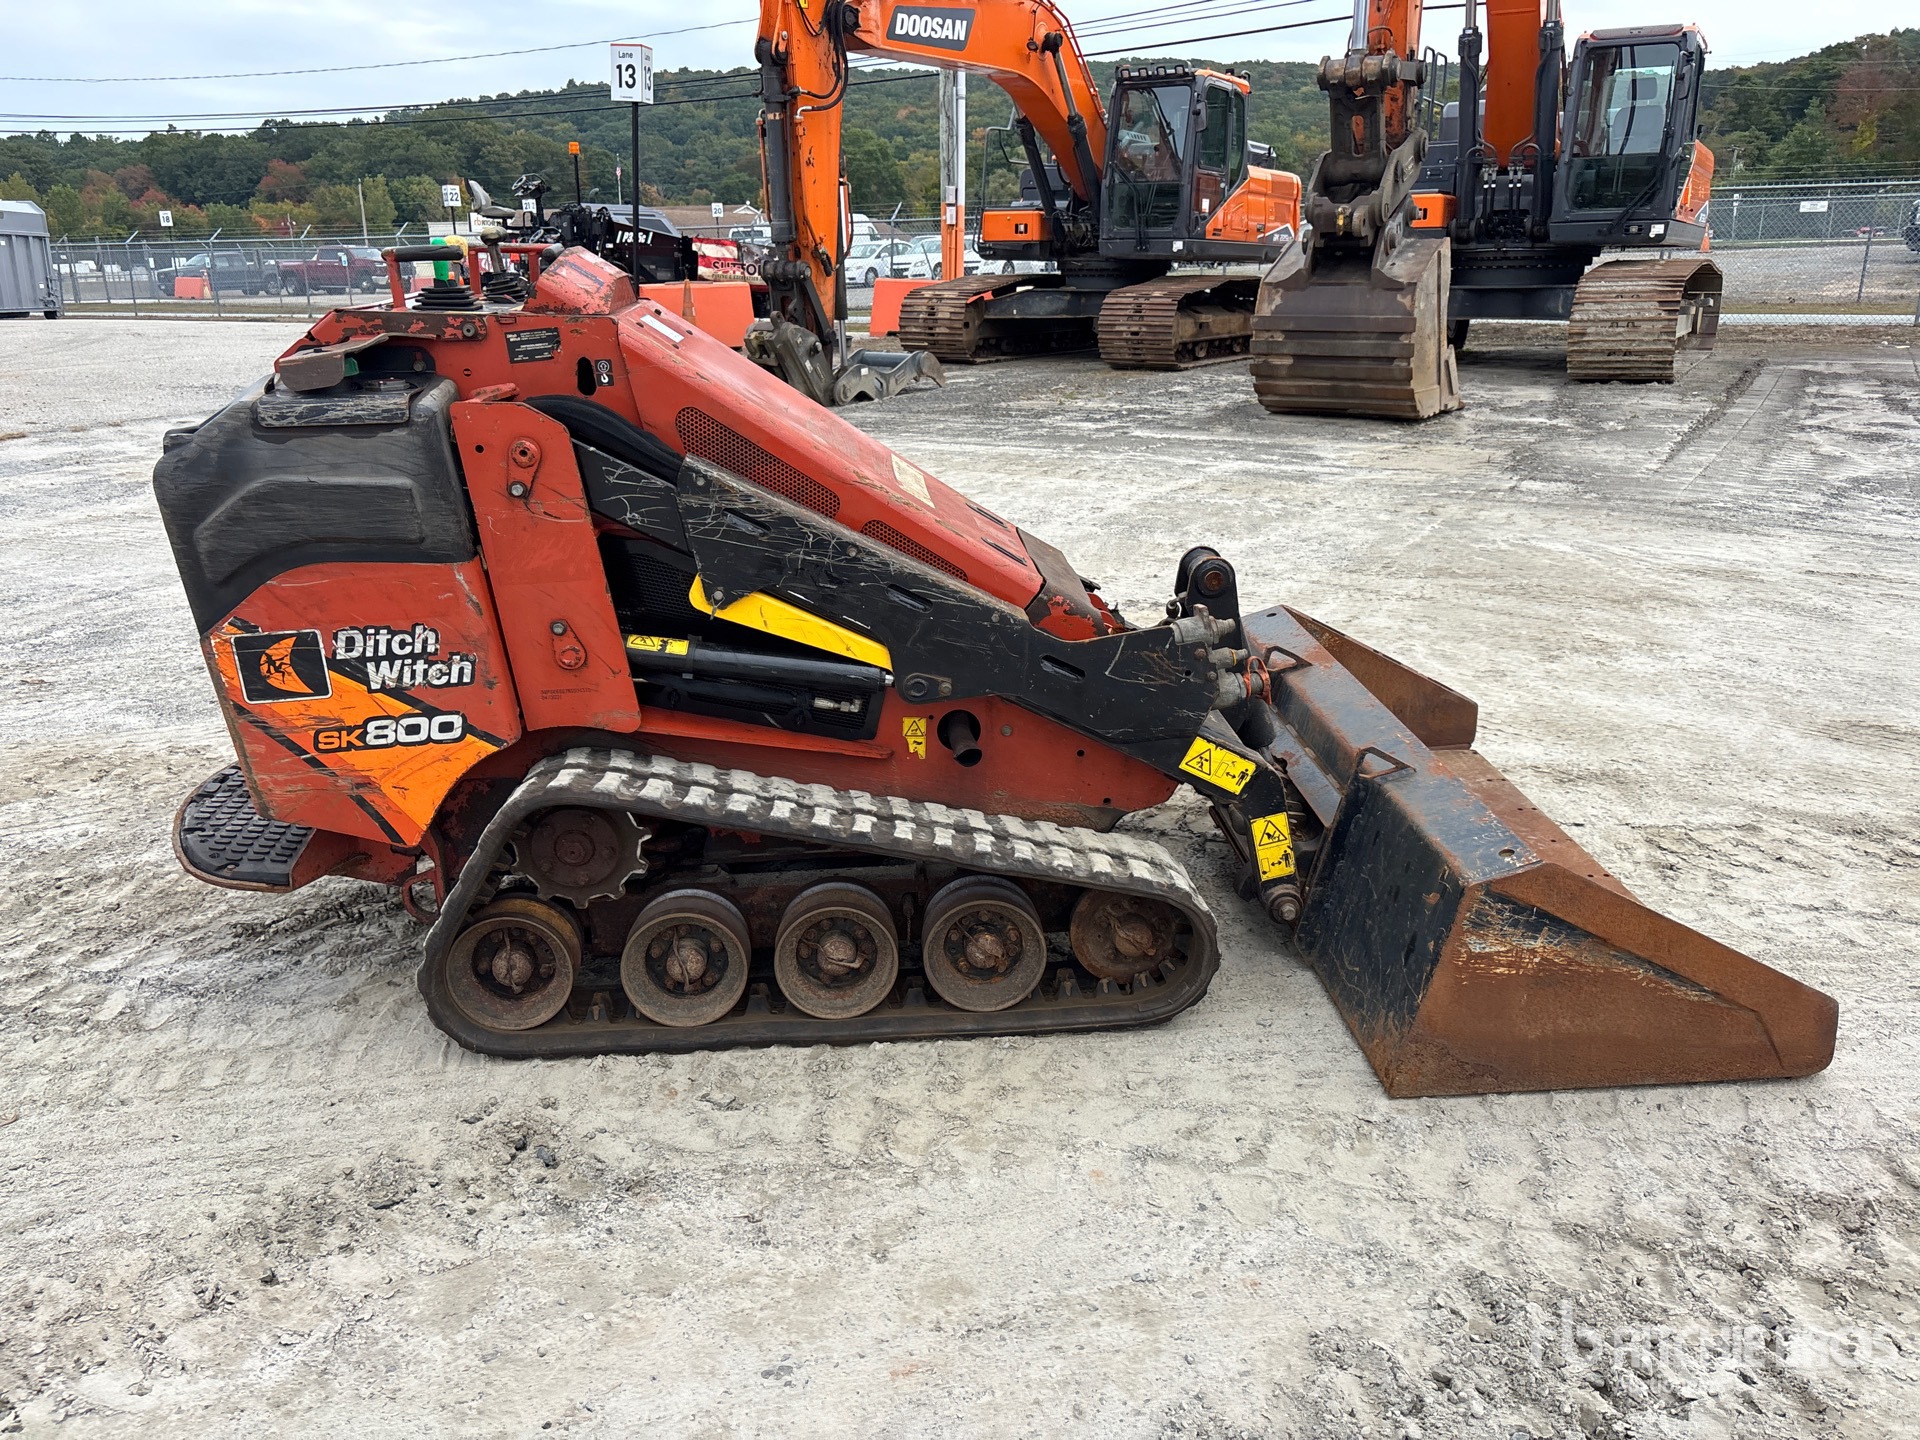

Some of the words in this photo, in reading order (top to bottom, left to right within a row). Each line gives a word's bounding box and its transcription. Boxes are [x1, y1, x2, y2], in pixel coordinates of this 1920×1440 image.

[895, 12, 967, 41] DOOSAN
[618, 50, 633, 58] Lane
[616, 63, 636, 89] 13
[644, 65, 652, 91] 13
[449, 191, 460, 202] 22
[524, 201, 531, 210] 21
[713, 207, 722, 215] 20
[162, 215, 170, 223] 18
[622, 231, 647, 244] P35c
[712, 260, 761, 276] SUTTO
[335, 624, 437, 660] Ditch
[366, 654, 472, 690] Witch
[318, 713, 463, 750] SK800
